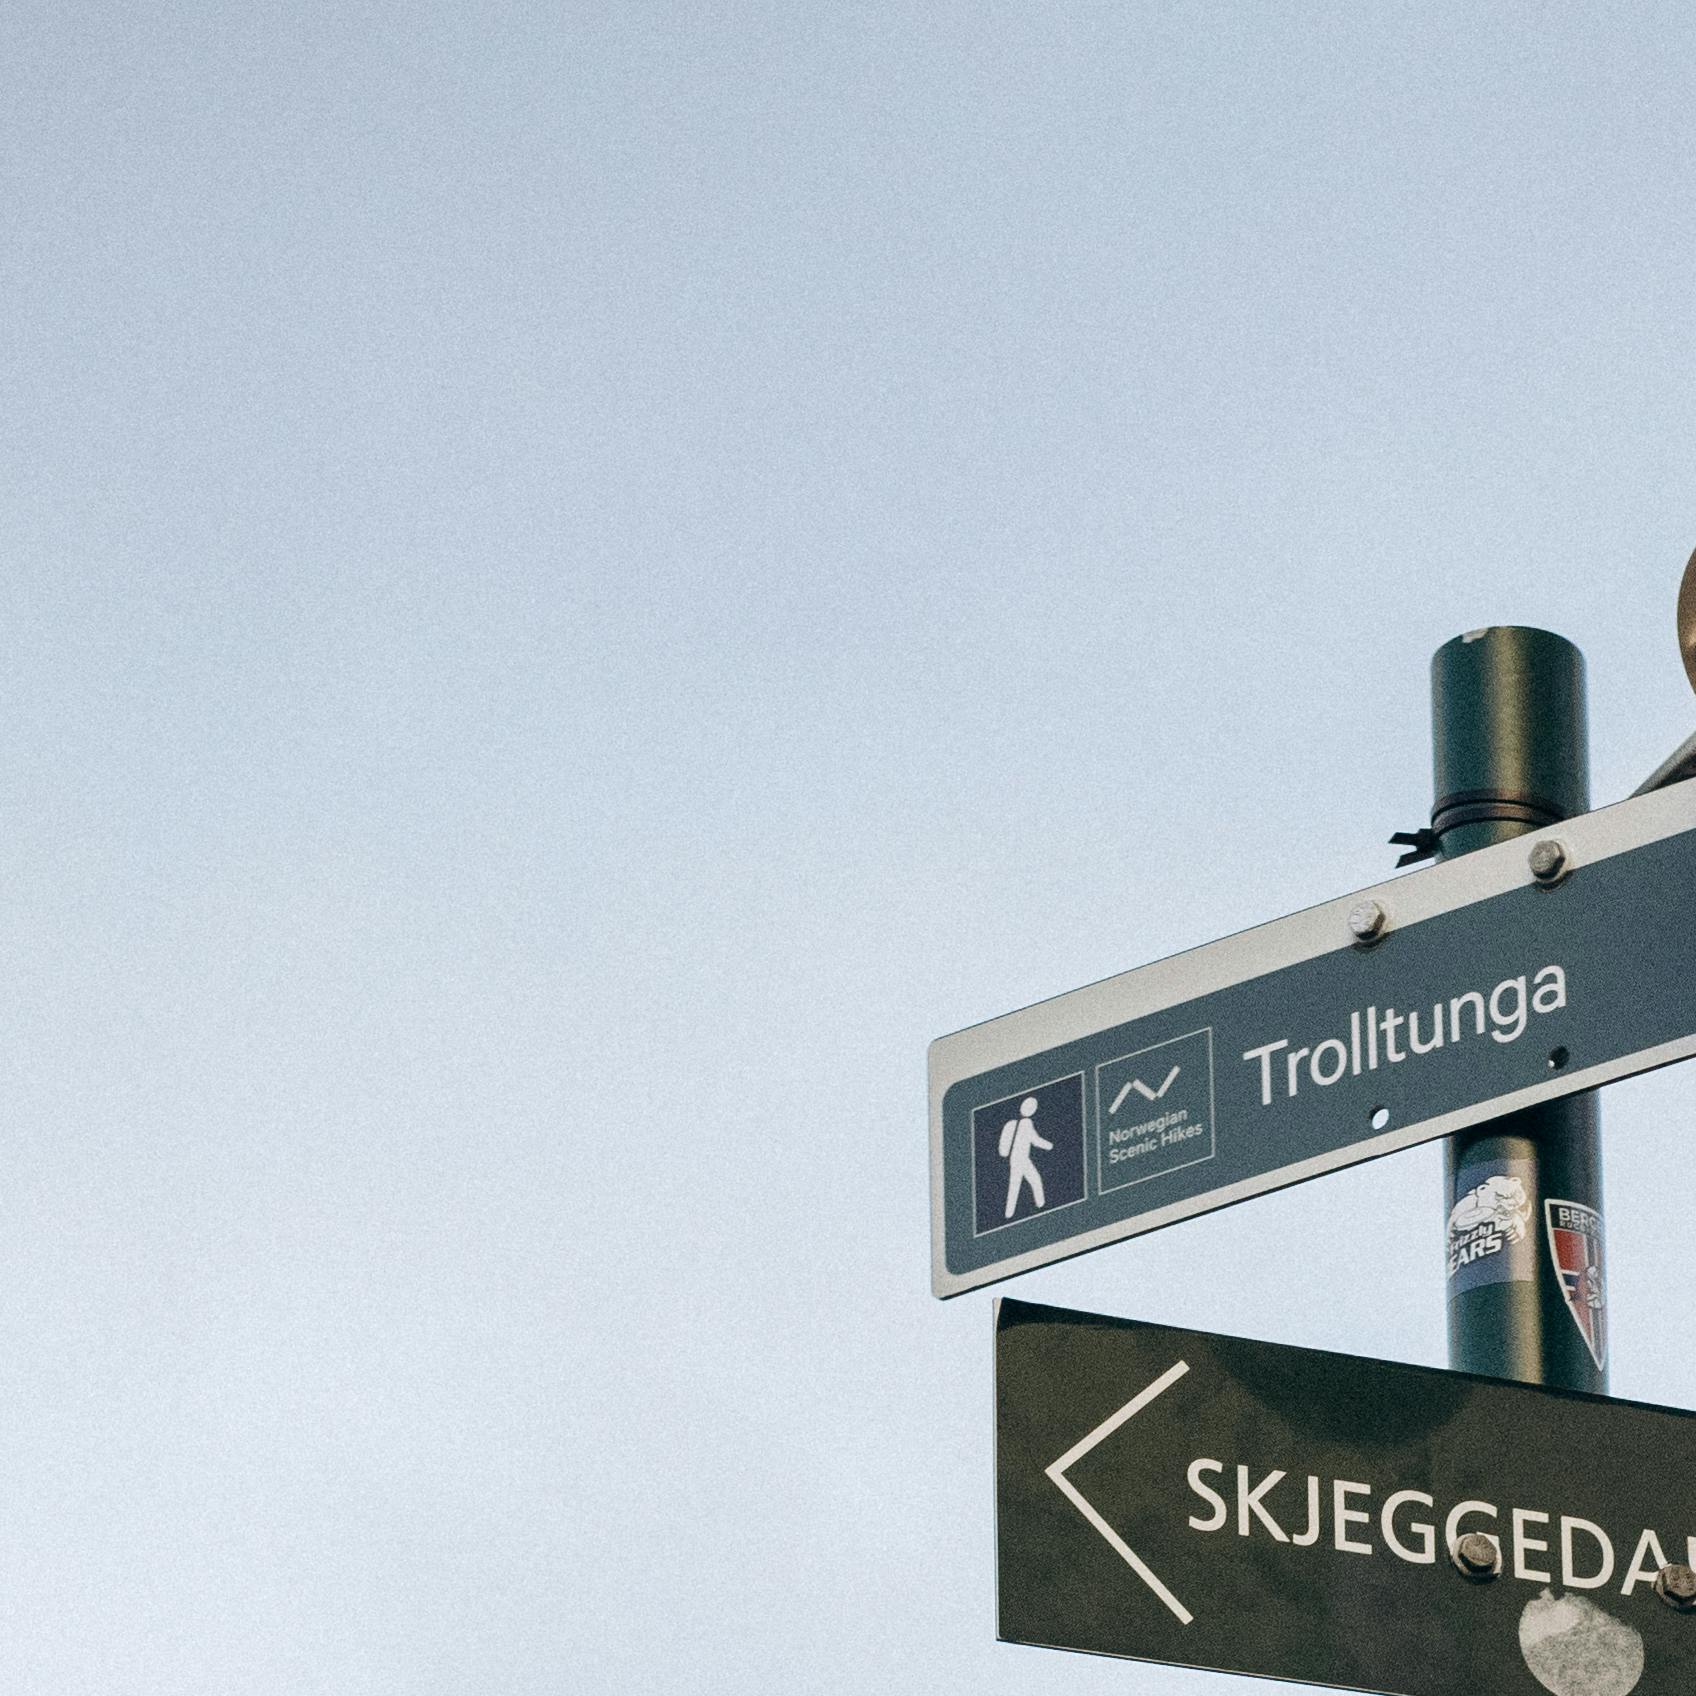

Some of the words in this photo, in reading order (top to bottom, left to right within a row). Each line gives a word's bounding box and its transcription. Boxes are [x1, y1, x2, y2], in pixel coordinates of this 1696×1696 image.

[1243, 965, 1566, 1106] Trolltunga
[1109, 1109, 1188, 1145] Norwegian
[1109, 1138, 1158, 1163] Scenic
[1161, 1123, 1203, 1146] Hikes
[1449, 1233, 1503, 1276] EARS
[1451, 1221, 1493, 1249] rizzly
